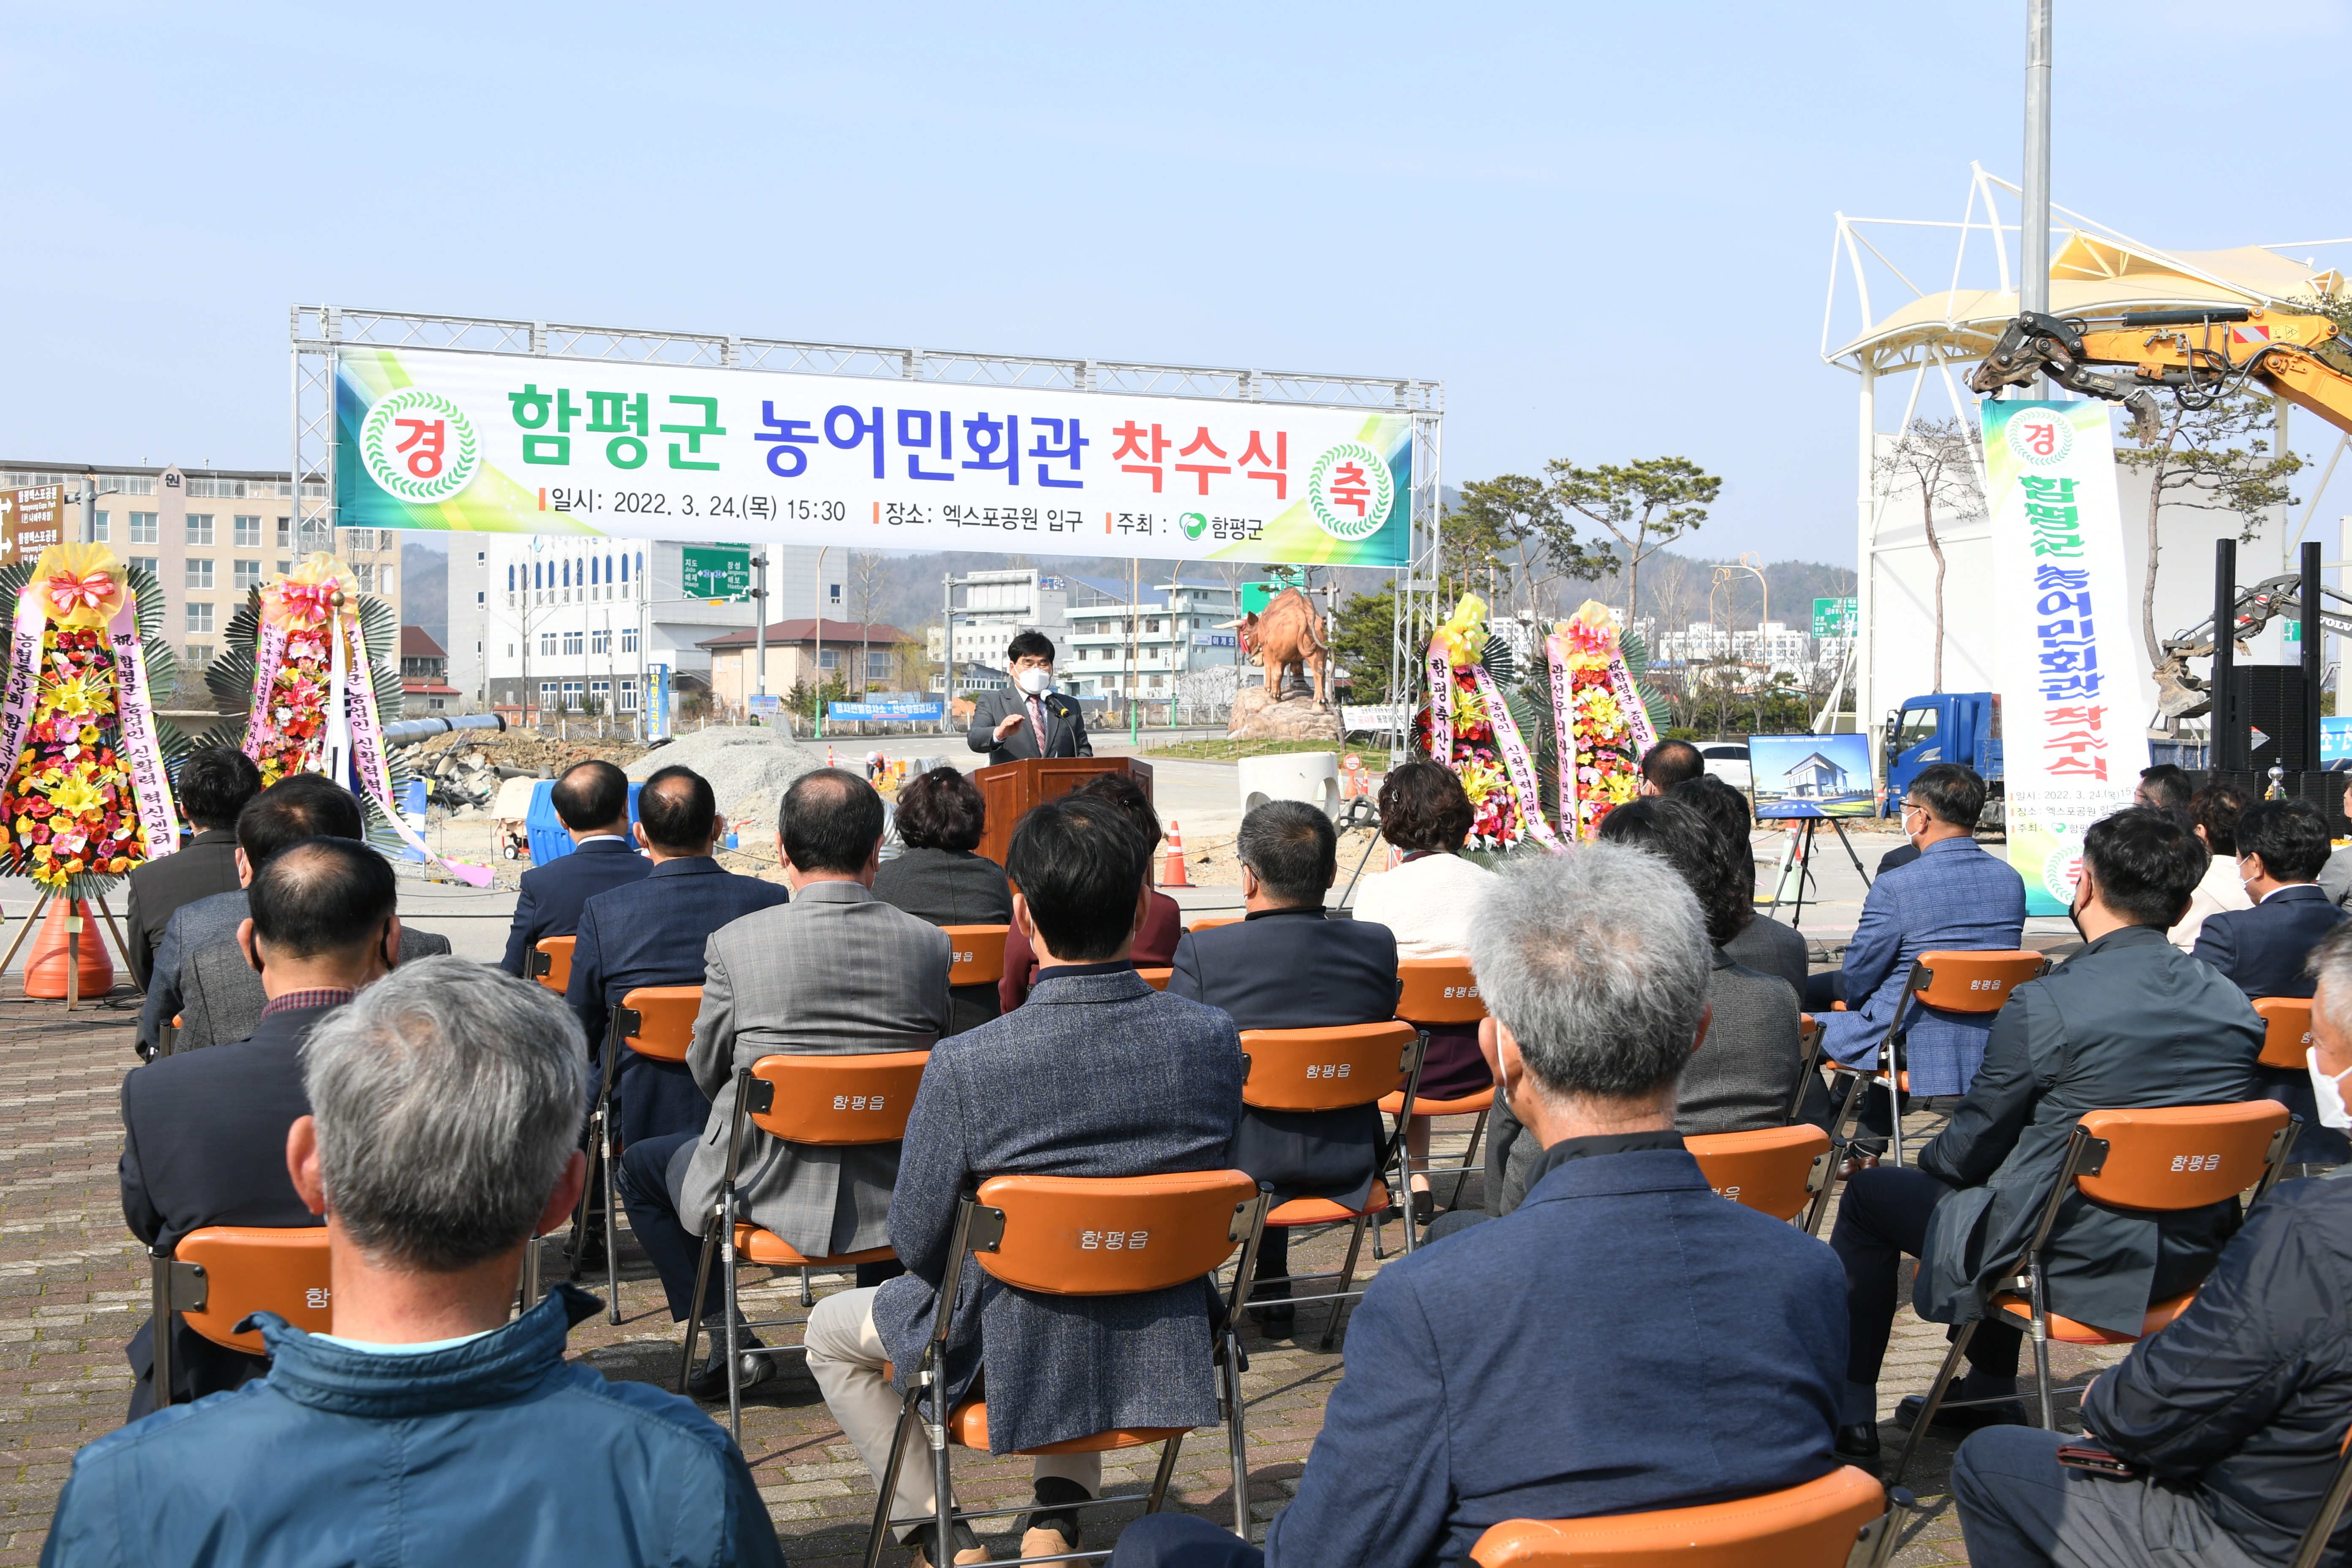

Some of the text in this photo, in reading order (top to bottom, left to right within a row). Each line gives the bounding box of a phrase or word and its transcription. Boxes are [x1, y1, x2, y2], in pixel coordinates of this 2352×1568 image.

[395, 419, 444, 479] 경
[508, 383, 1287, 500] 함평군 농어민회관 착수식
[2024, 424, 2055, 455] 경
[165, 474, 180, 487] 원
[1329, 461, 1371, 517] 축
[18, 486, 57, 503] 함평엑스포공원
[551, 487, 846, 522] 일시: 2022. 3. 24.(목) 15:30
[885, 502, 1083, 533] 장소: 엑스포공원 입구
[2017, 474, 2085, 557] 함평군
[18, 529, 57, 545] 함평엑스포공원
[1211, 516, 1264, 542] 함평군
[685, 559, 698, 567] 지도
[727, 561, 740, 570] 장성
[727, 576, 740, 584] 해보
[118, 655, 141, 696] 함평군
[651, 674, 659, 734] 자동차극장
[122, 702, 146, 740] 농업인
[1489, 701, 1511, 732] 농업인
[2043, 705, 2108, 782] 착수식
[2046, 807, 2096, 817] 엑스포공원
[2069, 824, 2088, 834] 함평
[952, 951, 973, 963] 평읍
[1443, 985, 1479, 998] 함평읍
[1970, 979, 2001, 991] 함평읍
[1306, 1063, 1351, 1079] 함평읍
[833, 1095, 885, 1111] 함평읍
[2170, 1154, 2221, 1172] 함평읍
[1081, 1229, 1149, 1250] 함평읍
